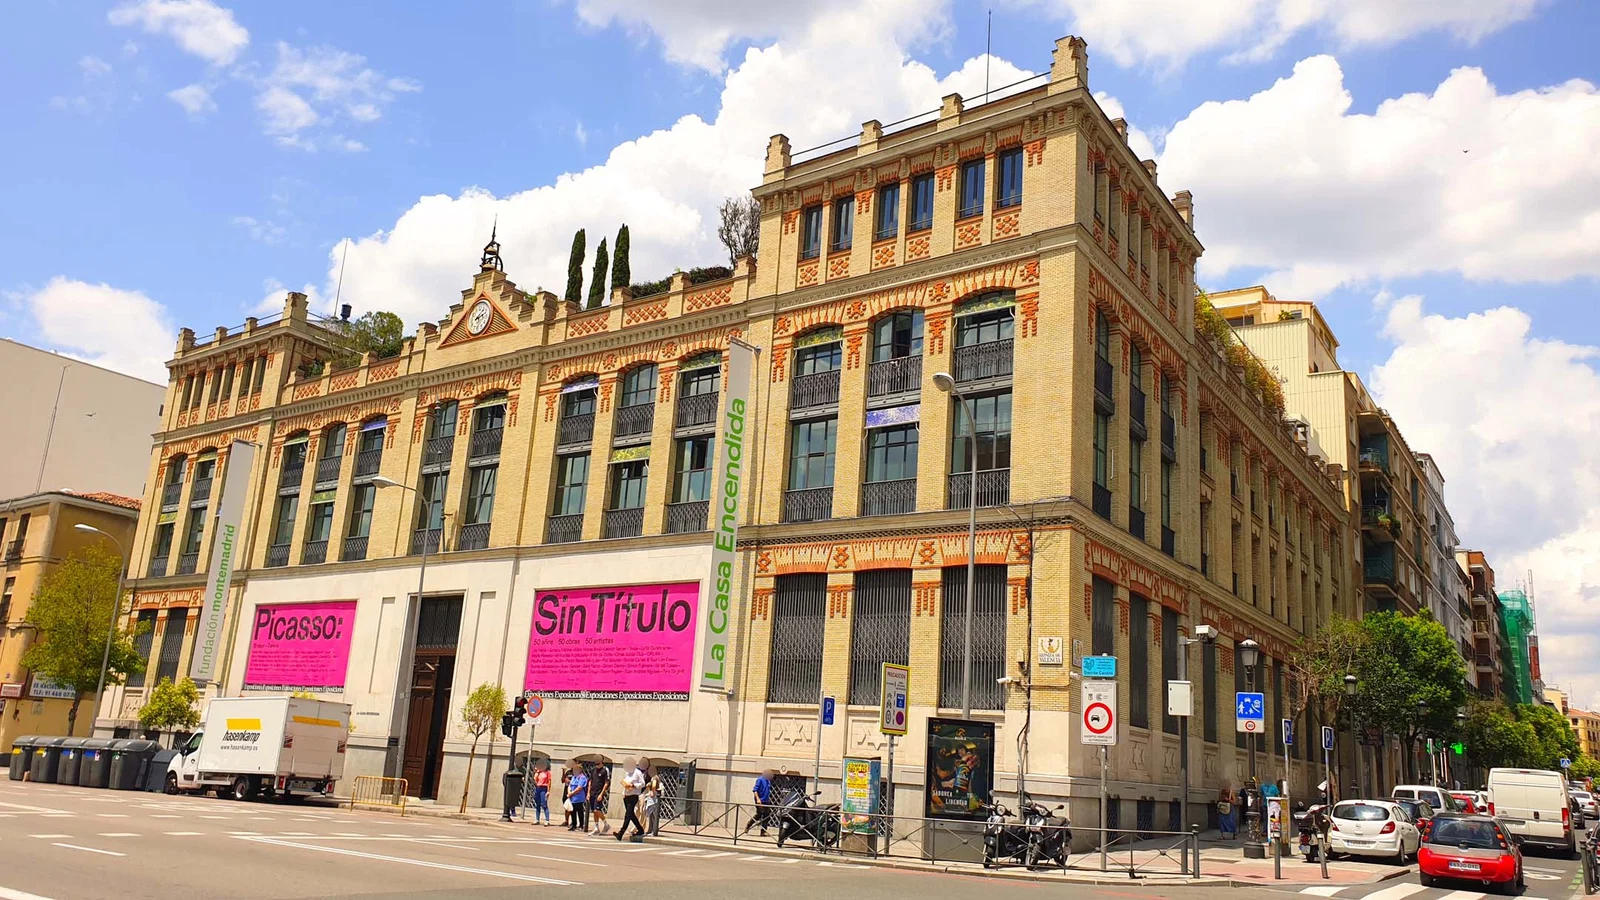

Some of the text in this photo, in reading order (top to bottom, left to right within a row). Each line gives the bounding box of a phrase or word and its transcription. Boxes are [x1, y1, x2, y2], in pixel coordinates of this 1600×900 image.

[704, 398, 746, 681] La Casa Encendida
[198, 524, 235, 675] fundación montemadrid
[535, 588, 692, 636] Sin Título
[254, 608, 344, 641] Picasso:
[222, 730, 261, 744] hasenkamp
